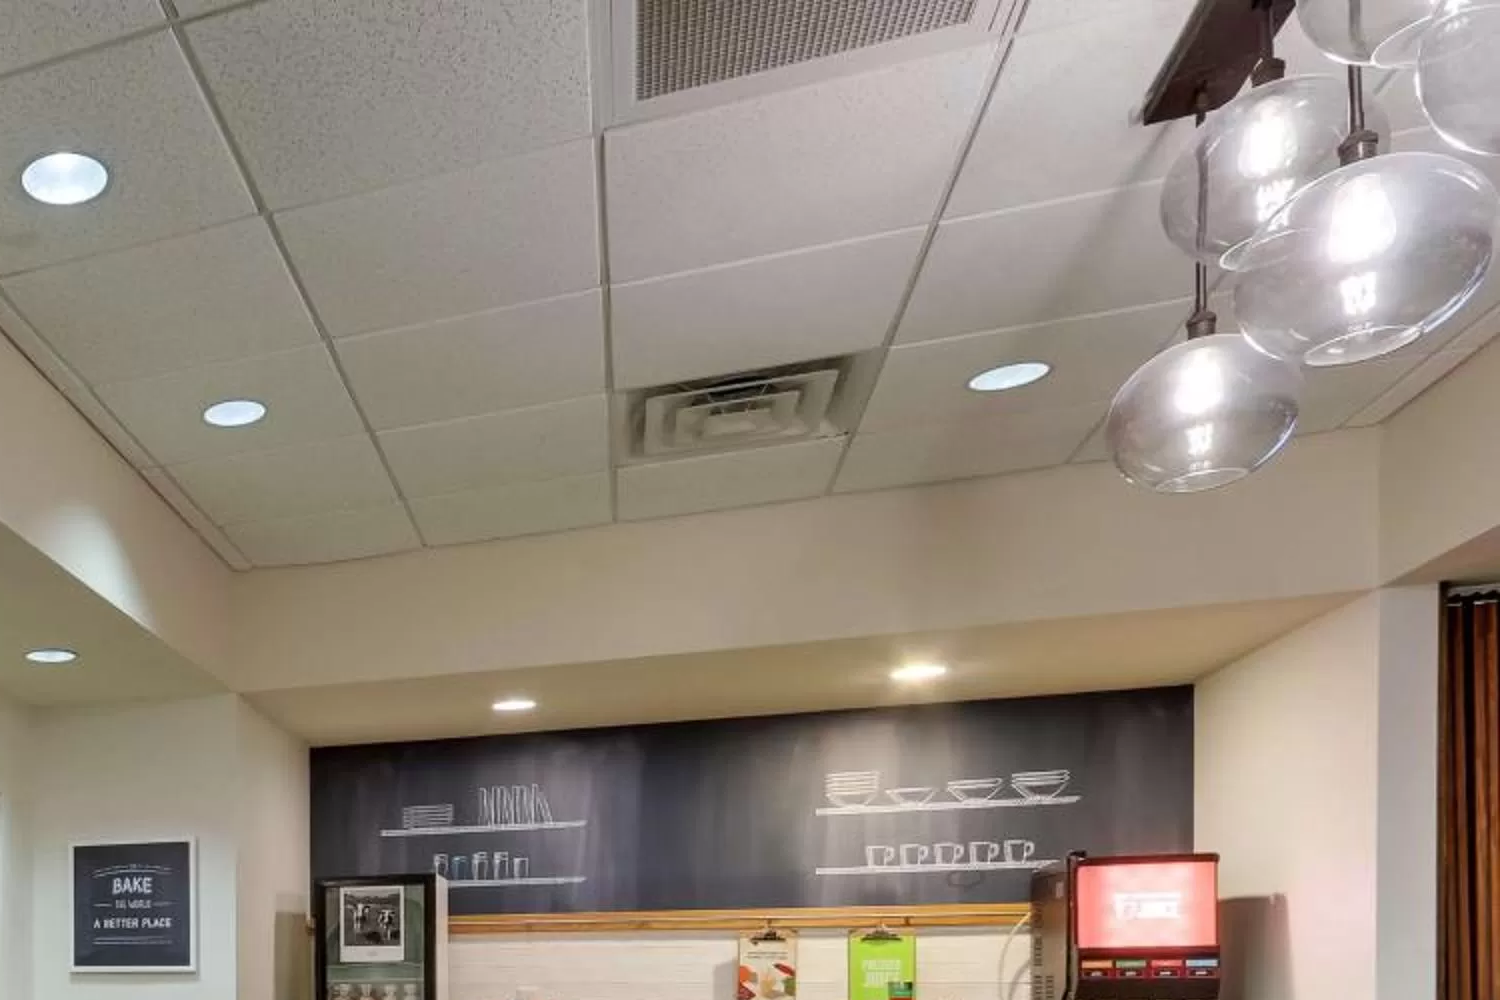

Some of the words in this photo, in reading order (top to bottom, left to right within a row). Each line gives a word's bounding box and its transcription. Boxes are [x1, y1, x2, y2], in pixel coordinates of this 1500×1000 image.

[112, 876, 153, 895] BAKE
[93, 918, 102, 929] A
[103, 918, 139, 929] BETTER
[141, 917, 173, 929] PLACE
